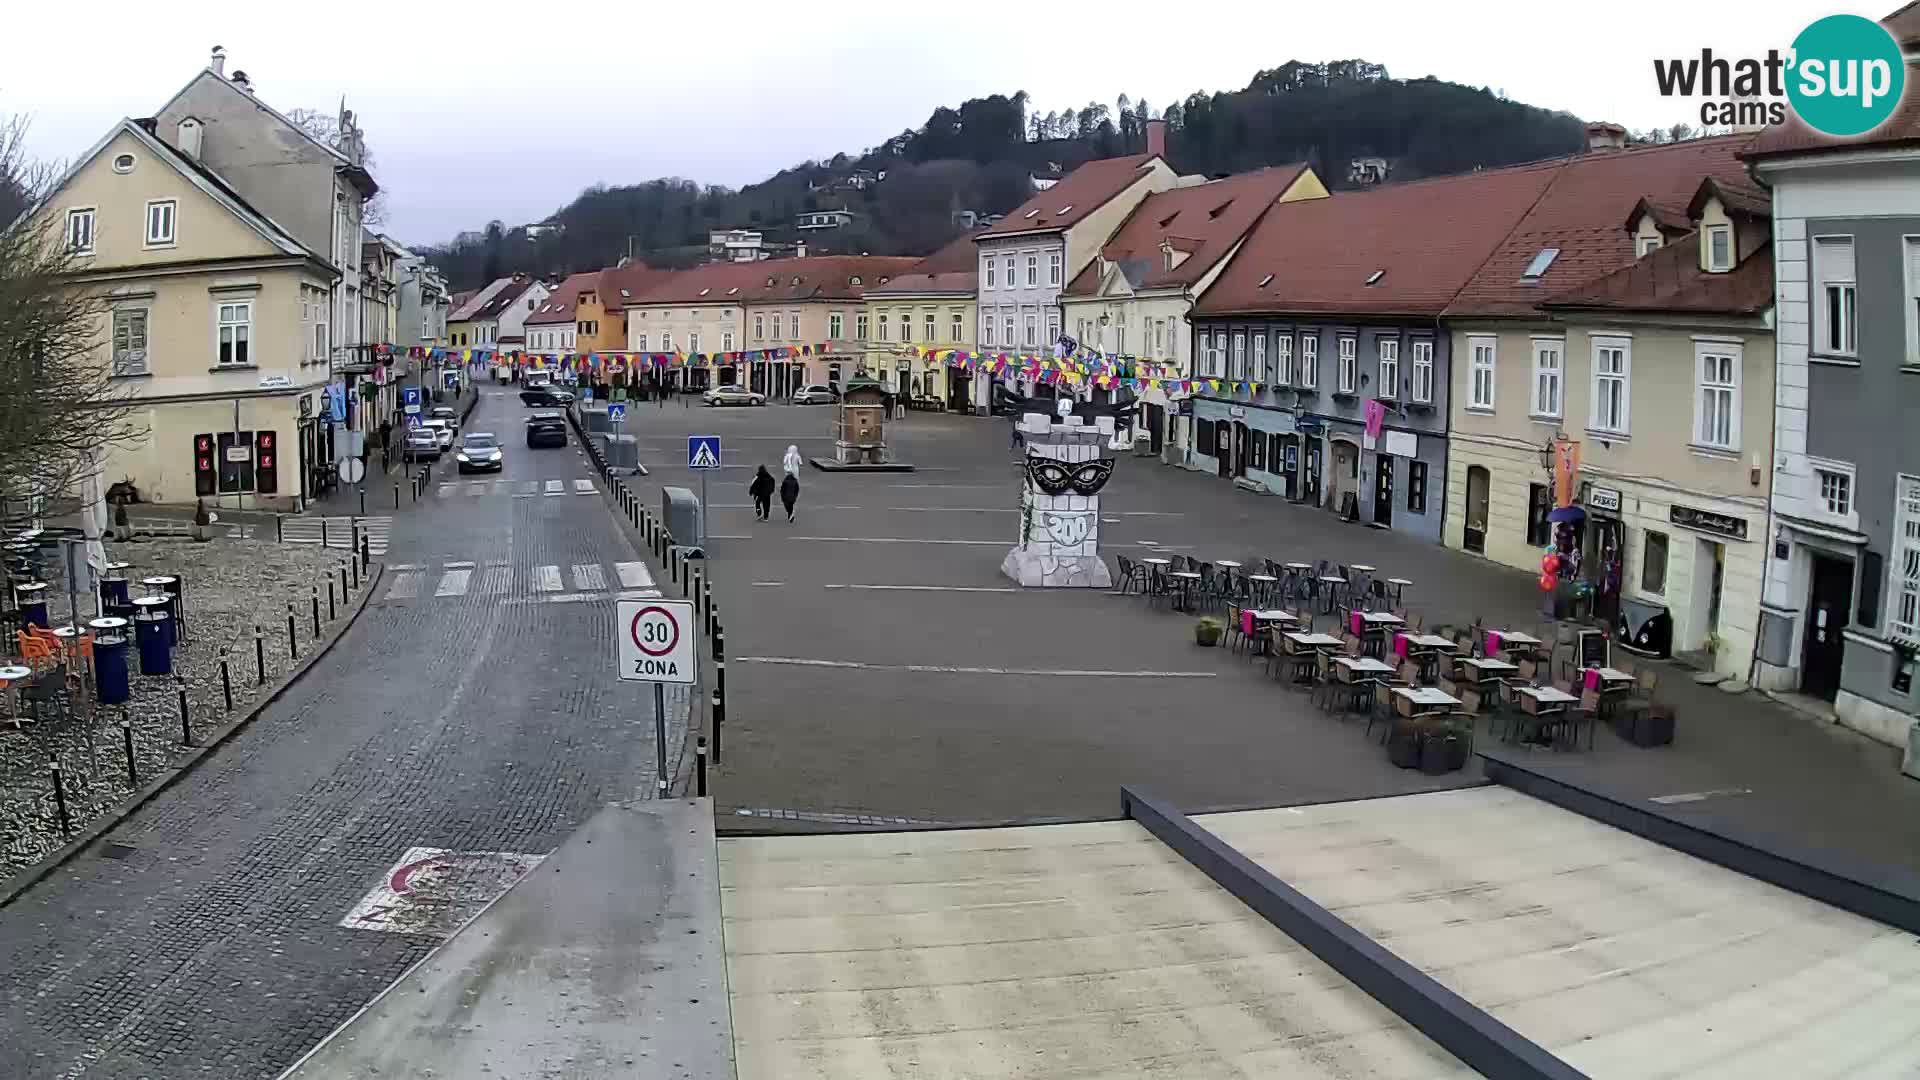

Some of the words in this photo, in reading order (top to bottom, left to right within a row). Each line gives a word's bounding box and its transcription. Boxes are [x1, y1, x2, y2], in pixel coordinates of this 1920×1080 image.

[409, 392, 416, 402] P
[1048, 516, 1088, 545] 200
[644, 622, 668, 643] 30
[634, 659, 678, 676] ZONA
